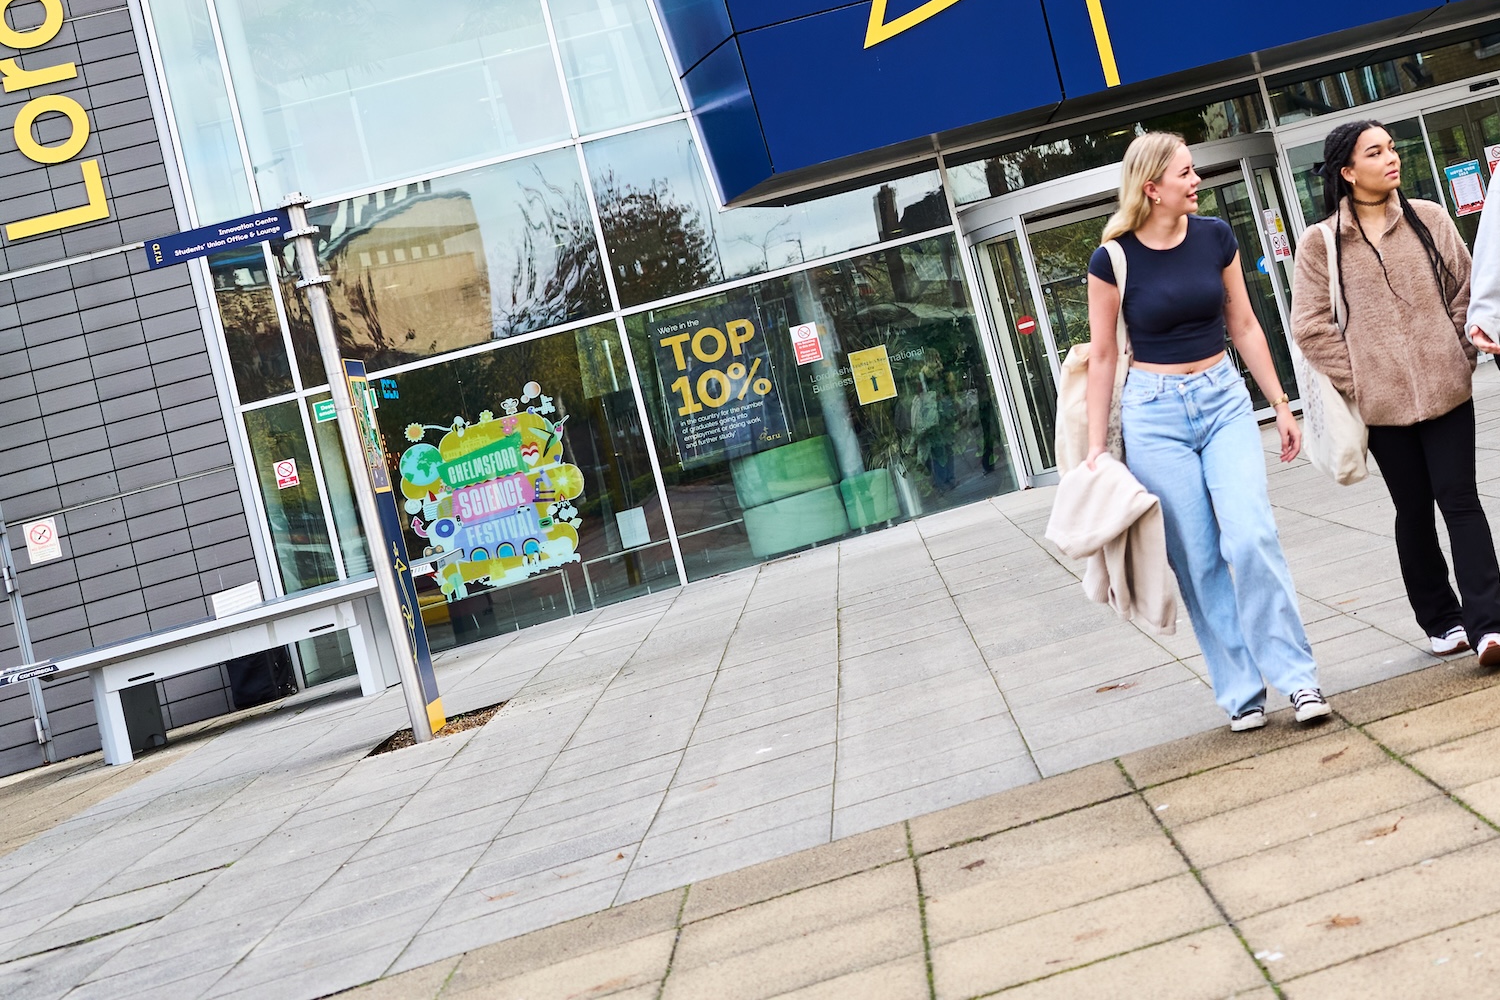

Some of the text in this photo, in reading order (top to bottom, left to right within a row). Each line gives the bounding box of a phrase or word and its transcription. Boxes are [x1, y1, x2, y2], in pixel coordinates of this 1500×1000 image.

[207, 238, 226, 249] Union
[226, 234, 249, 244] Office
[256, 225, 281, 236] Lounge
[218, 215, 278, 236] Innovation Centre
[657, 324, 678, 335] We're
[687, 319, 699, 327] the
[660, 318, 755, 371] TOP
[671, 357, 772, 417] 10%
[810, 370, 832, 383] Lord
[812, 376, 854, 394] Business
[687, 417, 697, 425] the
[698, 412, 720, 424] country
[740, 401, 764, 411] number
[689, 421, 719, 434] graduates
[719, 415, 737, 426] going
[684, 427, 721, 442] employment
[728, 420, 746, 431] doing
[747, 416, 762, 425] work
[686, 439, 698, 449] and
[698, 435, 718, 446] further
[447, 446, 518, 484] CHELMSFORD
[458, 477, 525, 519] SCIENCE
[464, 510, 538, 548] FESTIVAL
